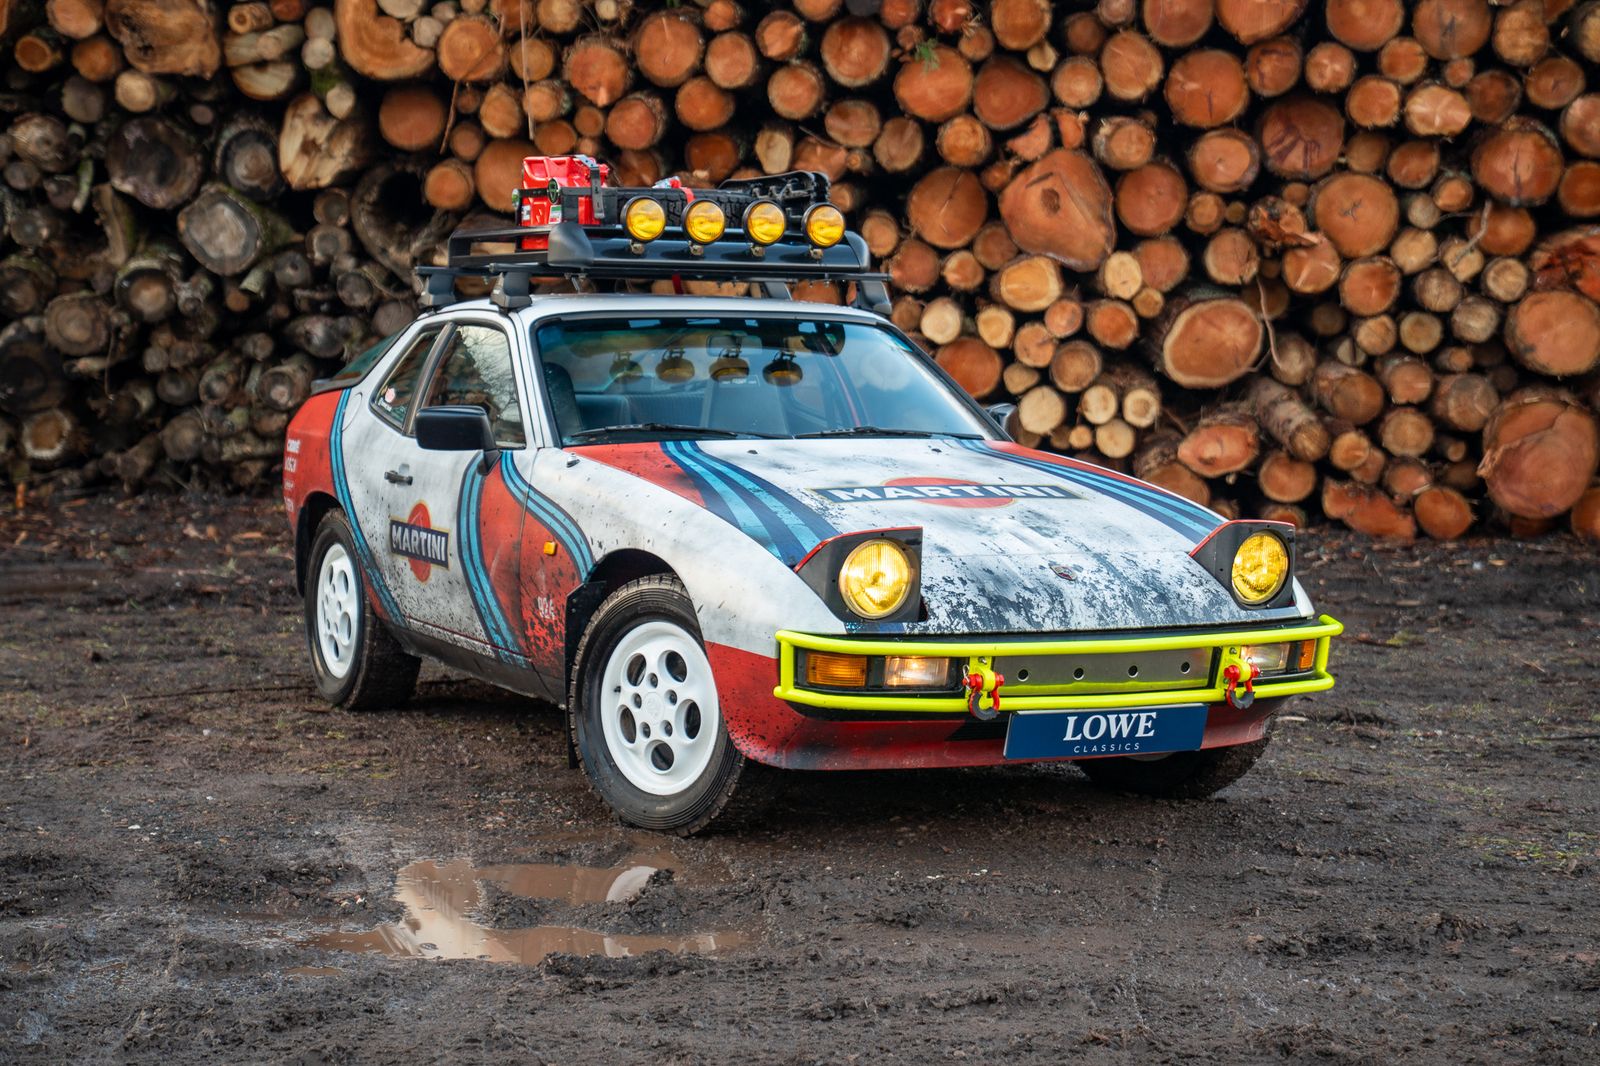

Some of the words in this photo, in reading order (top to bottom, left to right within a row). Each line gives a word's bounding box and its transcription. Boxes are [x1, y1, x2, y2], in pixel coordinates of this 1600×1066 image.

[828, 485, 1066, 500] MARTINI
[391, 524, 446, 562] MARTINI
[1063, 711, 1157, 742] LOWE
[1073, 742, 1141, 753] CLASSICS
